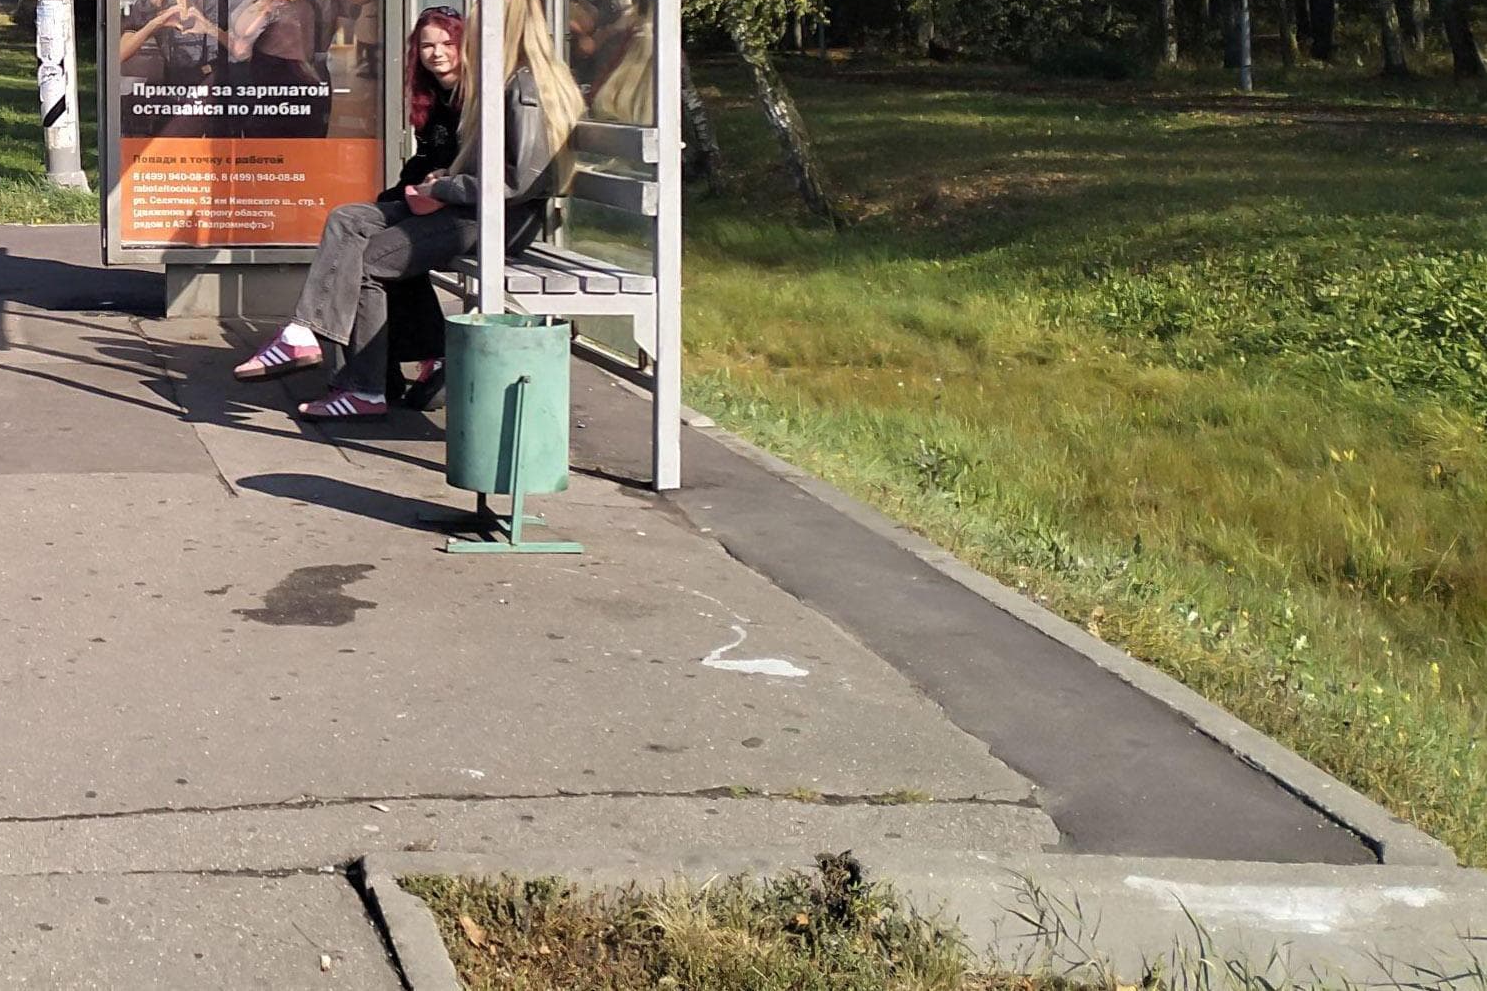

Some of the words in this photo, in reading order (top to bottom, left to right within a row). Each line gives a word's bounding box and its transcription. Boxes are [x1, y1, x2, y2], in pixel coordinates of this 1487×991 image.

[132, 82, 209, 99] Приходи
[212, 86, 232, 97] за
[236, 82, 330, 100] зарплатой
[132, 101, 223, 115] оставайся
[227, 104, 249, 115] по
[252, 102, 311, 116] любви
[133, 154, 177, 164] Попади
[190, 157, 222, 165] точку
[235, 155, 284, 165] работой
[142, 172, 166, 182] (499)
[221, 173, 228, 181] 8
[229, 172, 255, 182] (499)
[229, 196, 280, 205] Киевского
[298, 198, 317, 207] стр.
[195, 210, 232, 218] сторону
